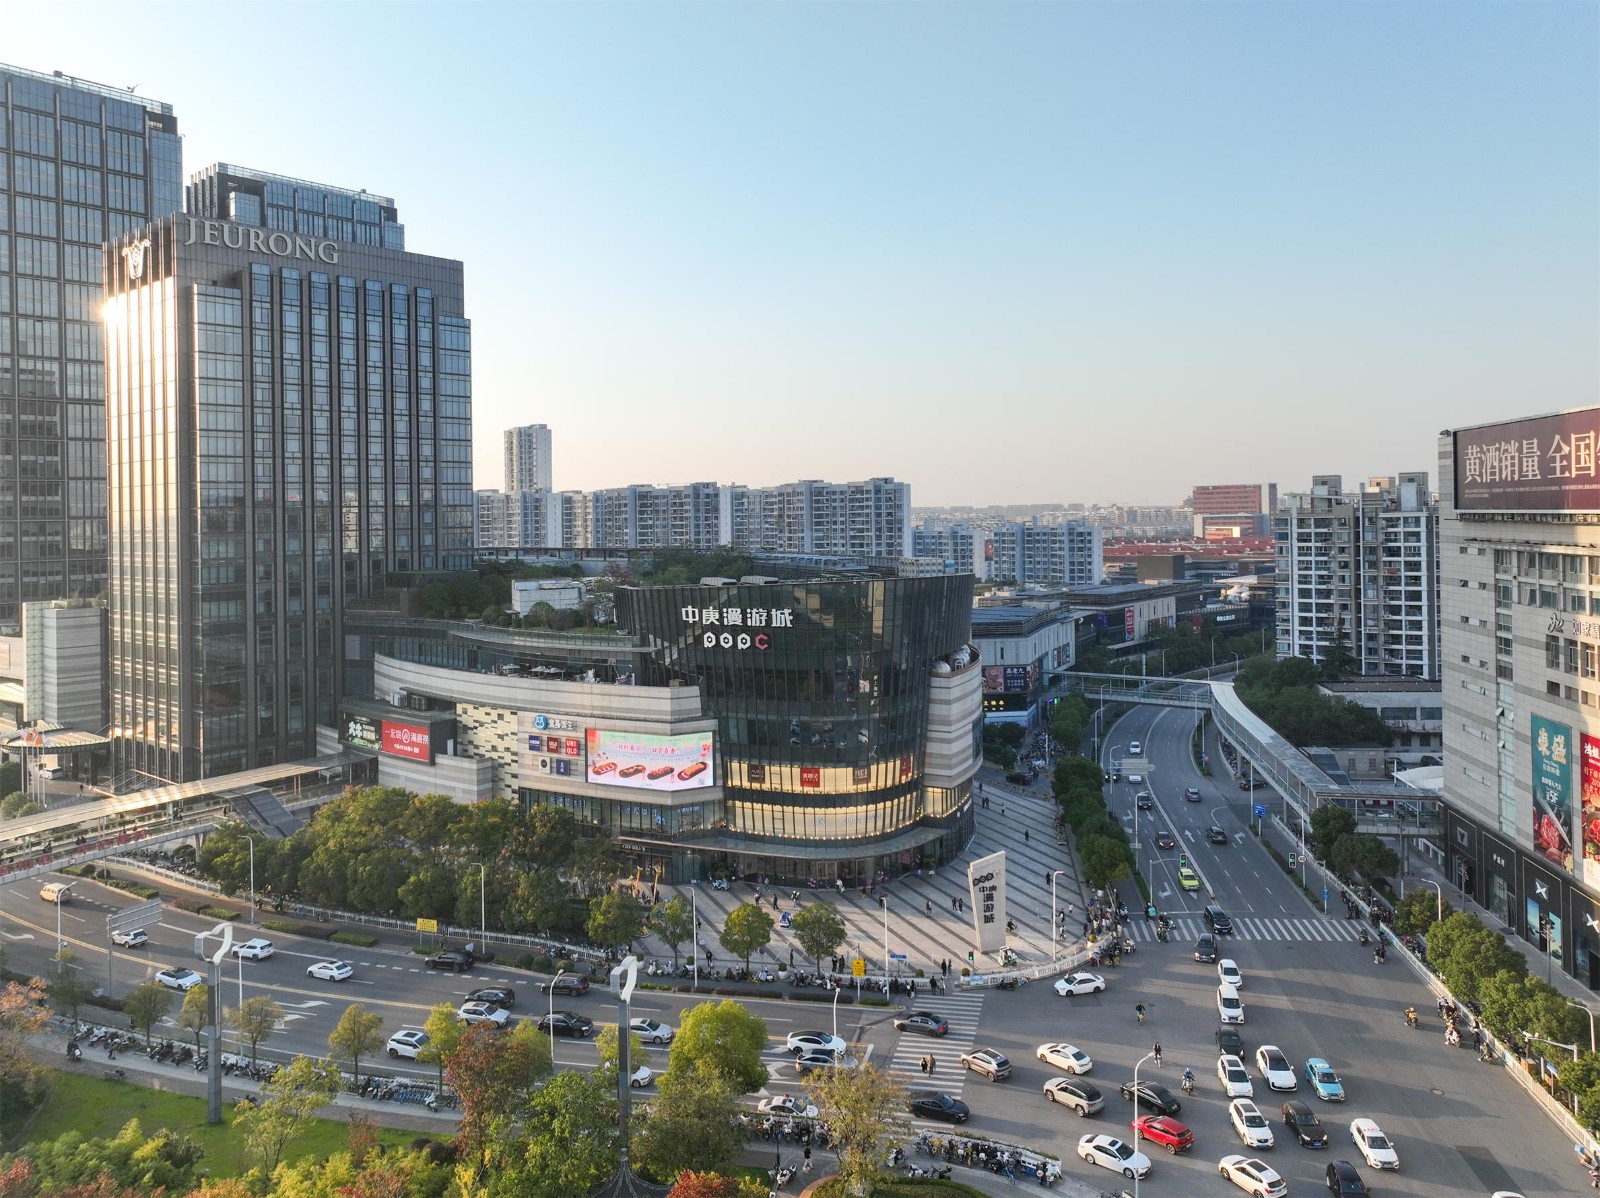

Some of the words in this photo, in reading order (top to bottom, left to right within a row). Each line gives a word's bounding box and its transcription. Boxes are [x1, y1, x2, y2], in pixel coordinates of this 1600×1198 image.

[184, 217, 340, 264] JEURONG
[1463, 437, 1542, 484] 黄酒销量
[1546, 429, 1600, 479] 全国
[681, 605, 794, 627] 中庚漫游城
[566, 739, 577, 747] UNI
[566, 747, 577, 755] QLO
